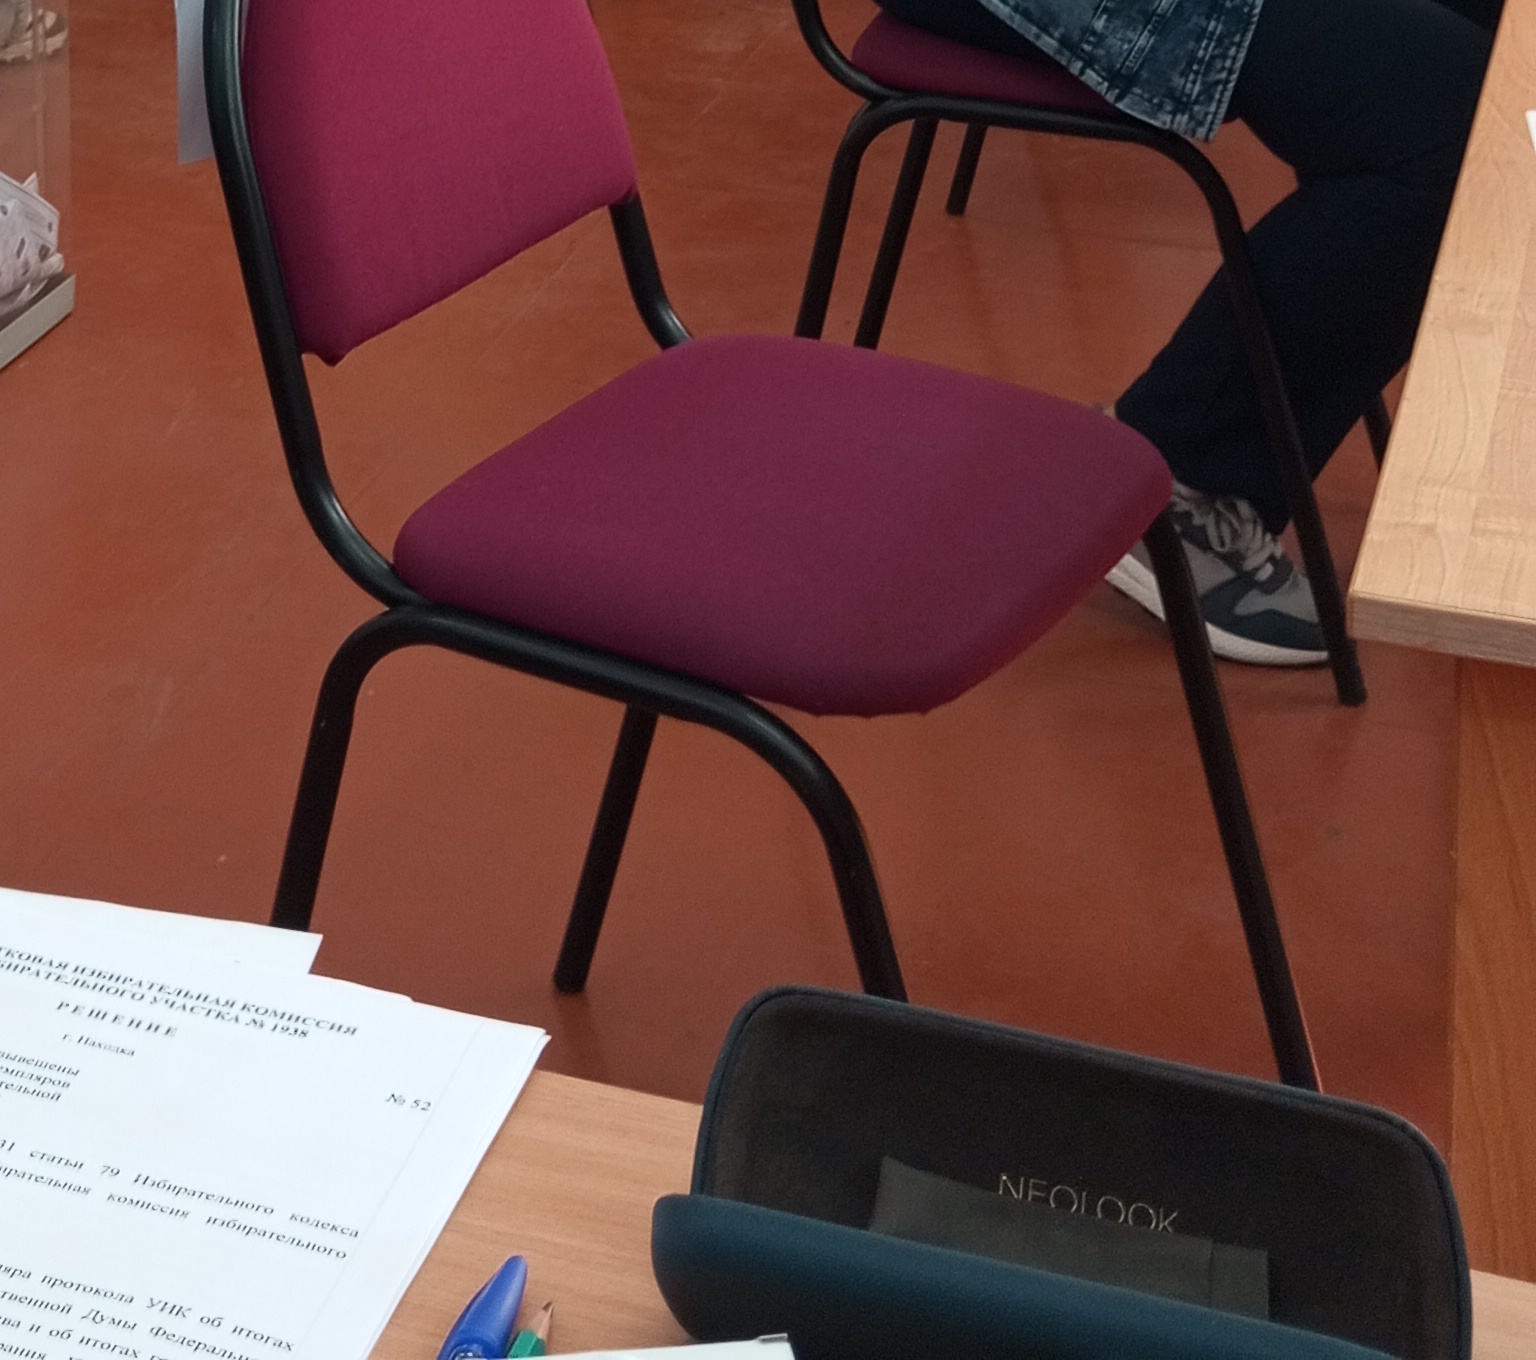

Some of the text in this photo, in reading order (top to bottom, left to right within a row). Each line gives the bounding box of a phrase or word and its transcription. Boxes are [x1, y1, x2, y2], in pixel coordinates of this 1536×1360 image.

[71, 964, 237, 1011] ИЗБИРАТЕЛЬНАЯ
[240, 1002, 359, 1037] КОМИССИЯ
[149, 995, 241, 1025] УЧАСТКА
[245, 1015, 265, 1030] №
[270, 1022, 310, 1039] 1938
[77, 1035, 136, 1057] Находка
[385, 1092, 432, 1112] № 52
[29, 1149, 85, 1171] статьи
[99, 1164, 121, 1178] 79
[133, 1172, 275, 1217] Избирательного
[288, 1212, 360, 1239] кодекса
[107, 1191, 191, 1220] комиссия
[204, 1215, 348, 1261] избирательного
[40, 1273, 135, 1306] протокола
[146, 1296, 193, 1320] УИК
[199, 1314, 225, 1329] об
[231, 1324, 295, 1352] итогах
[80, 1307, 139, 1332] Думы
[28, 1322, 42, 1335] и
[48, 1327, 75, 1341] об
[78, 1335, 142, 1360] итогах
